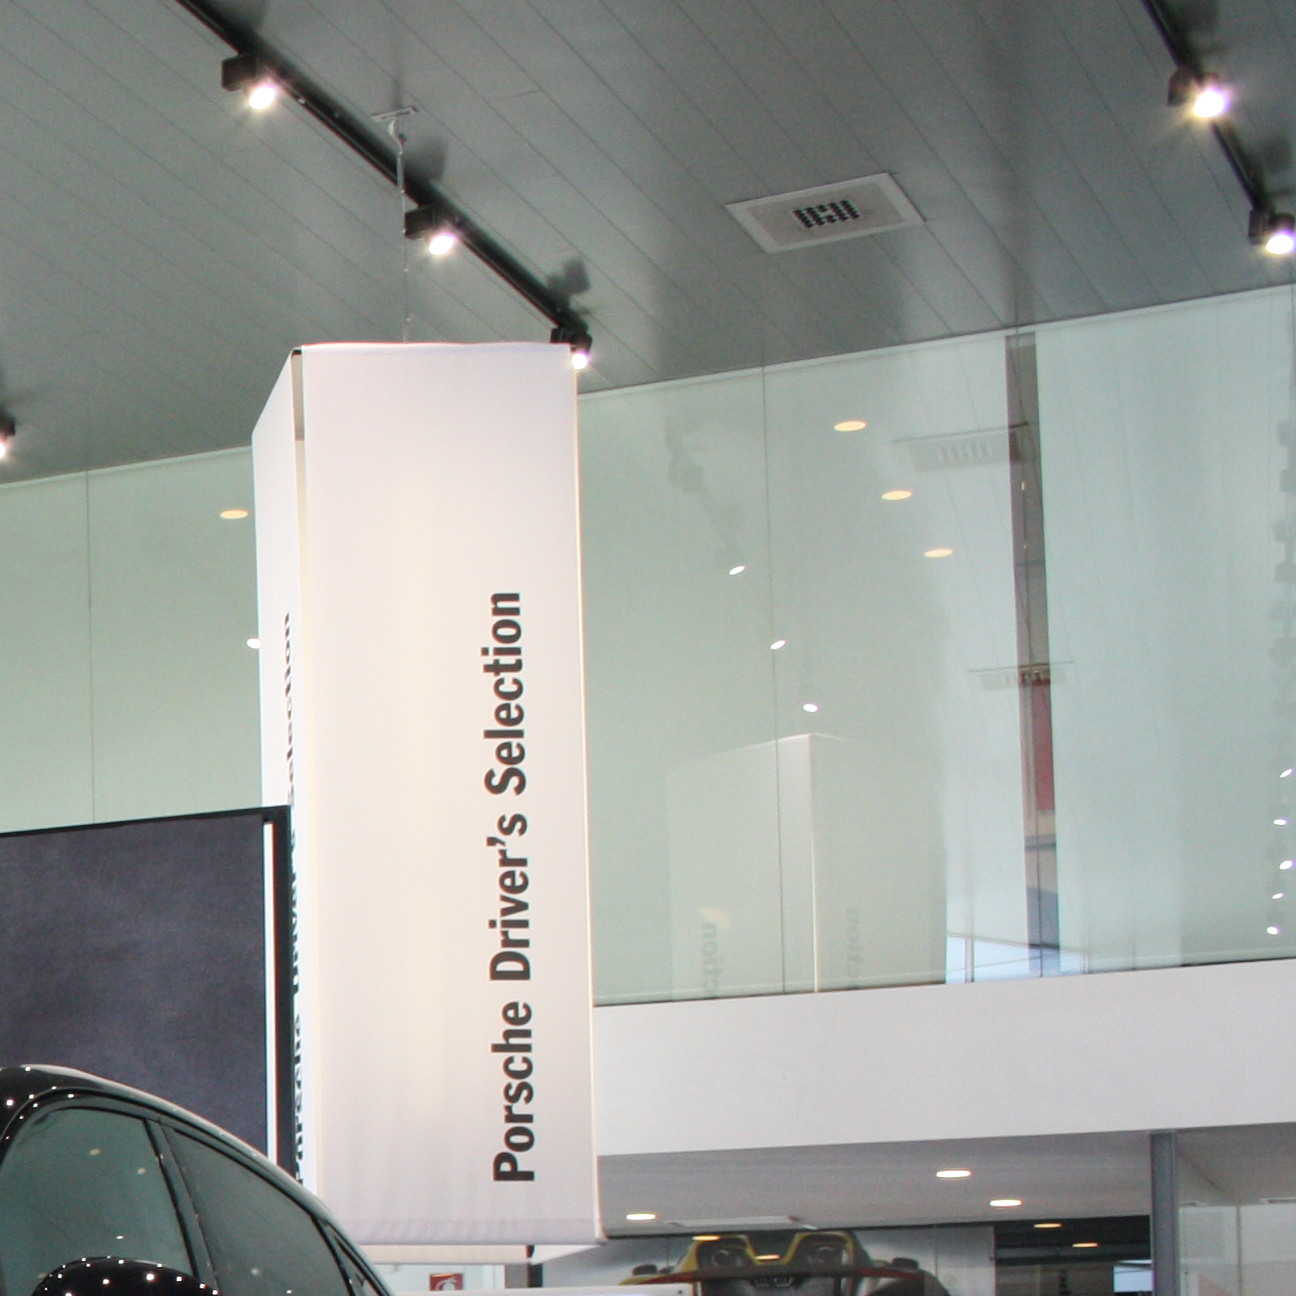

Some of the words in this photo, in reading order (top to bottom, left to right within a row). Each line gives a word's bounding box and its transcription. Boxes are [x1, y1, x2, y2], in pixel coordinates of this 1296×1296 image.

[481, 592, 528, 796] Selection
[485, 812, 531, 982] Driver's
[491, 1001, 535, 1182] Porsche
